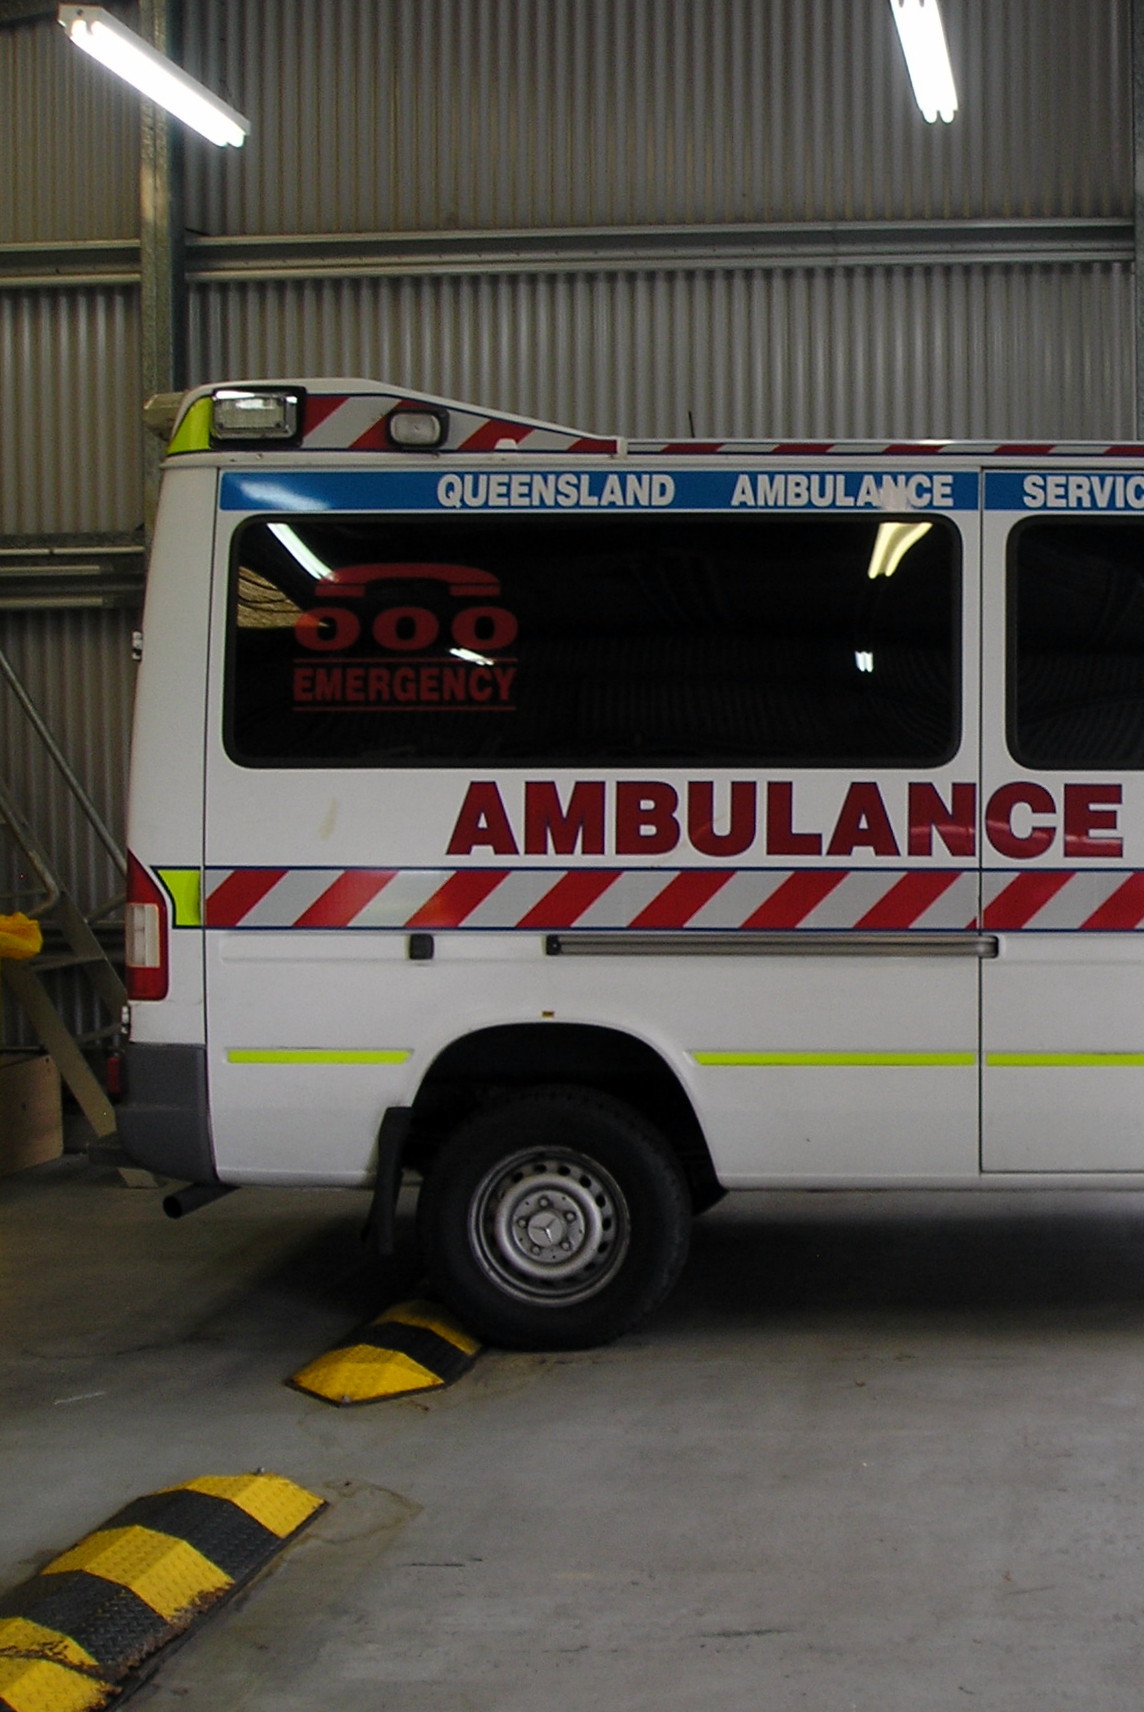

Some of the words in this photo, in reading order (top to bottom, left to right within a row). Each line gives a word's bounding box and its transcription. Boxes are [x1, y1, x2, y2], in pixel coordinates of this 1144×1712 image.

[437, 473, 675, 508] QUEENSLAND
[731, 474, 954, 507] AMBULANCE
[294, 606, 518, 650] 000
[293, 667, 517, 701] EMERGENCY
[445, 780, 1124, 859] AMBULANCE
